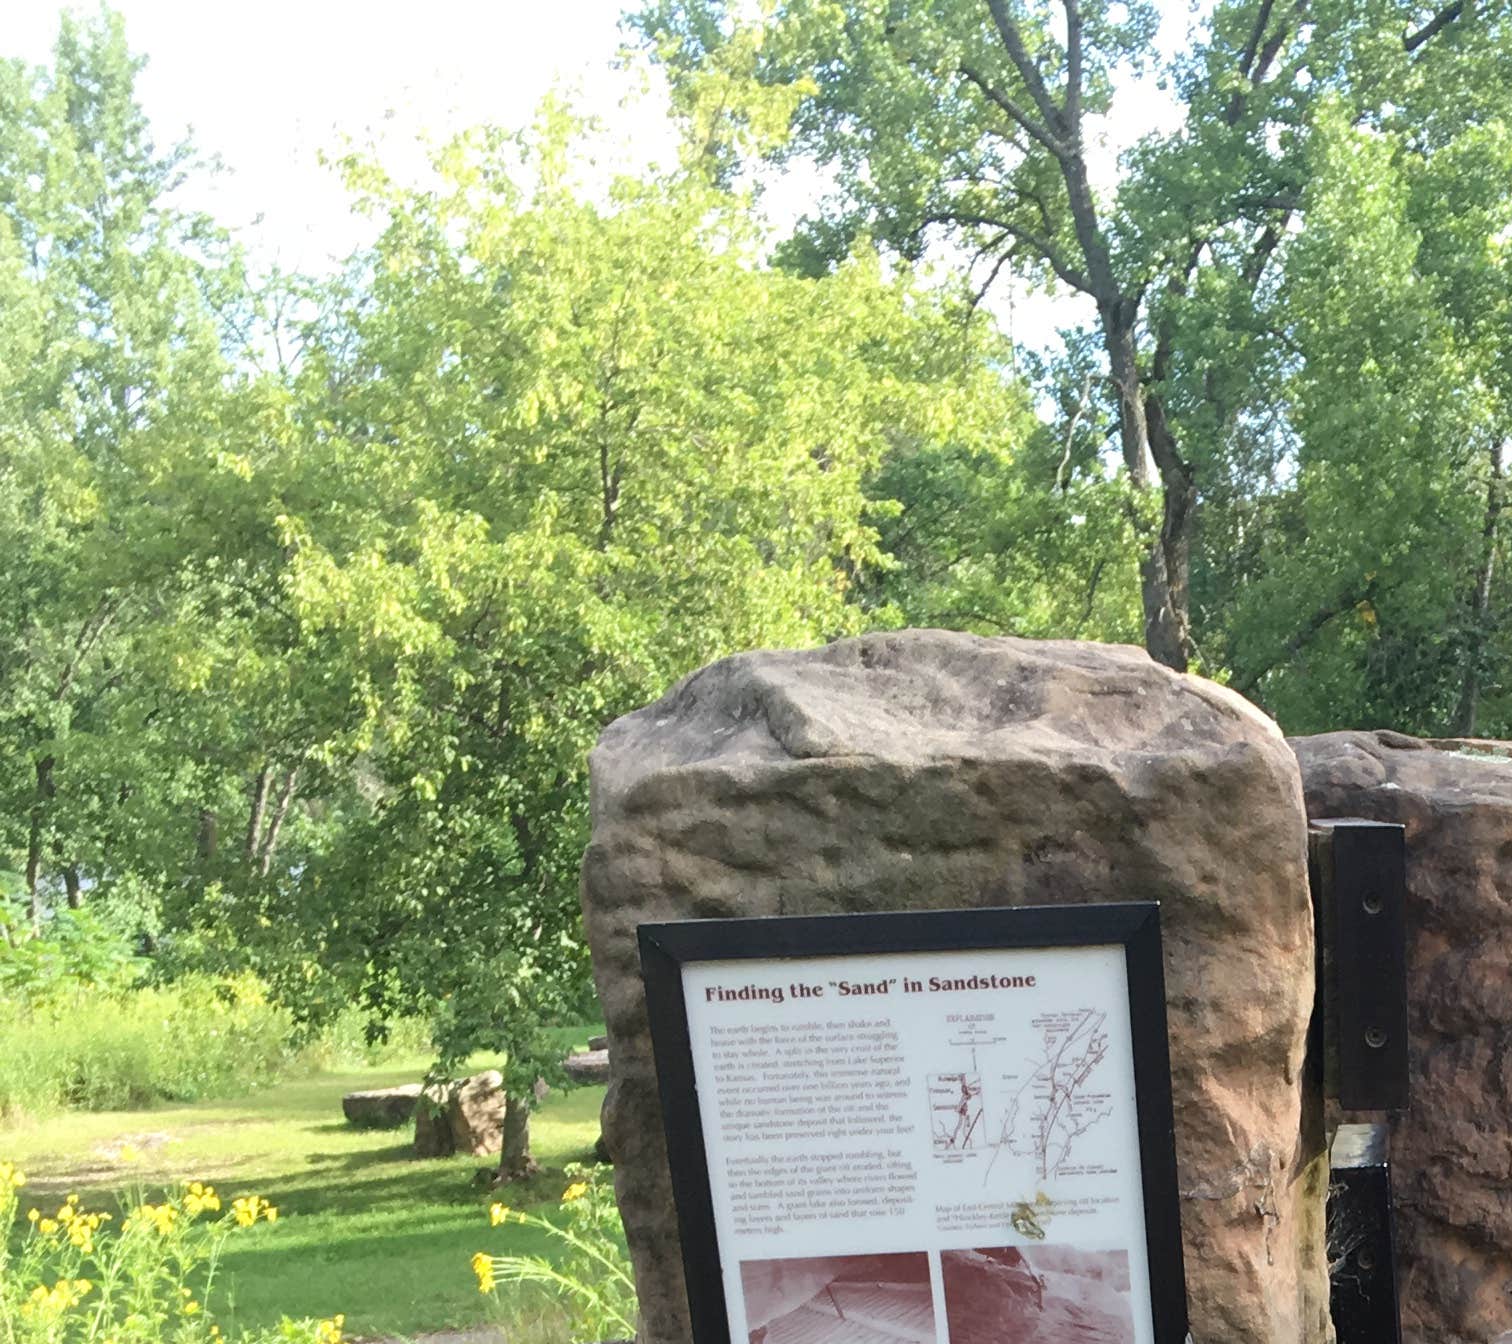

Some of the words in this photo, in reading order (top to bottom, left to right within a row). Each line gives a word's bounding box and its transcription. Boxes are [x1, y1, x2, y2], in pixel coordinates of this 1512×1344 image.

[705, 980, 783, 1005] Finding
[790, 979, 822, 997] the
[830, 976, 895, 996] "Sand"
[904, 975, 922, 993] in
[929, 971, 1035, 992] Sandstone
